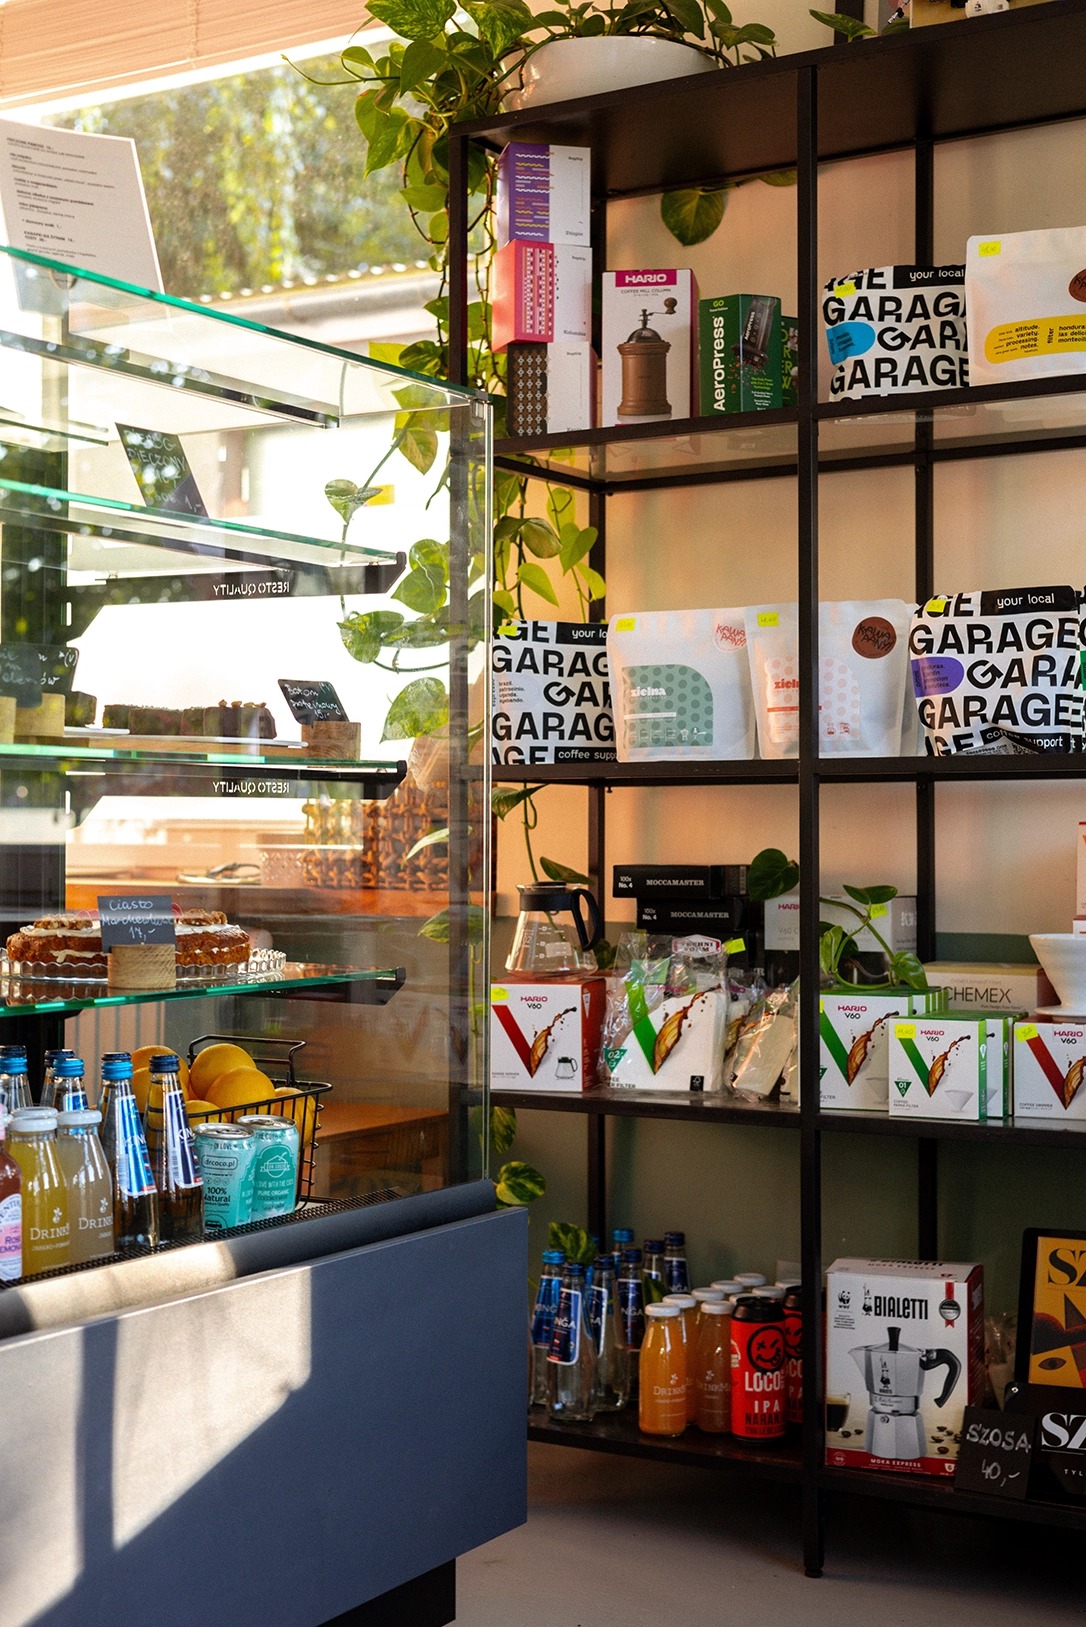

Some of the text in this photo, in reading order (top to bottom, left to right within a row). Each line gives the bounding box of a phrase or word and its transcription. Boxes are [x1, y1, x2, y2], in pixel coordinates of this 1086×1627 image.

[625, 274, 667, 284] HARIO
[910, 269, 965, 282] your local
[712, 300, 724, 308] GO
[822, 292, 966, 326] GARAG
[877, 320, 968, 352] GAR
[713, 316, 726, 412] AeroPress
[997, 593, 1055, 608] your local
[572, 628, 596, 640] your
[908, 618, 1078, 656] GARAGE
[630, 686, 666, 698] zielna
[918, 693, 1071, 730] GARAGE
[558, 750, 590, 760] coffee
[109, 900, 154, 911] Ciasto
[844, 1012, 861, 1020] V60
[1054, 1030, 1084, 1038] HARIO
[207, 1187, 228, 1195] 100%
[874, 1296, 928, 1320] BIALETTI
[745, 1370, 781, 1392] LOCO
[966, 1422, 1032, 1453] SZOSA
[892, 1460, 922, 1468] EXPRESS
